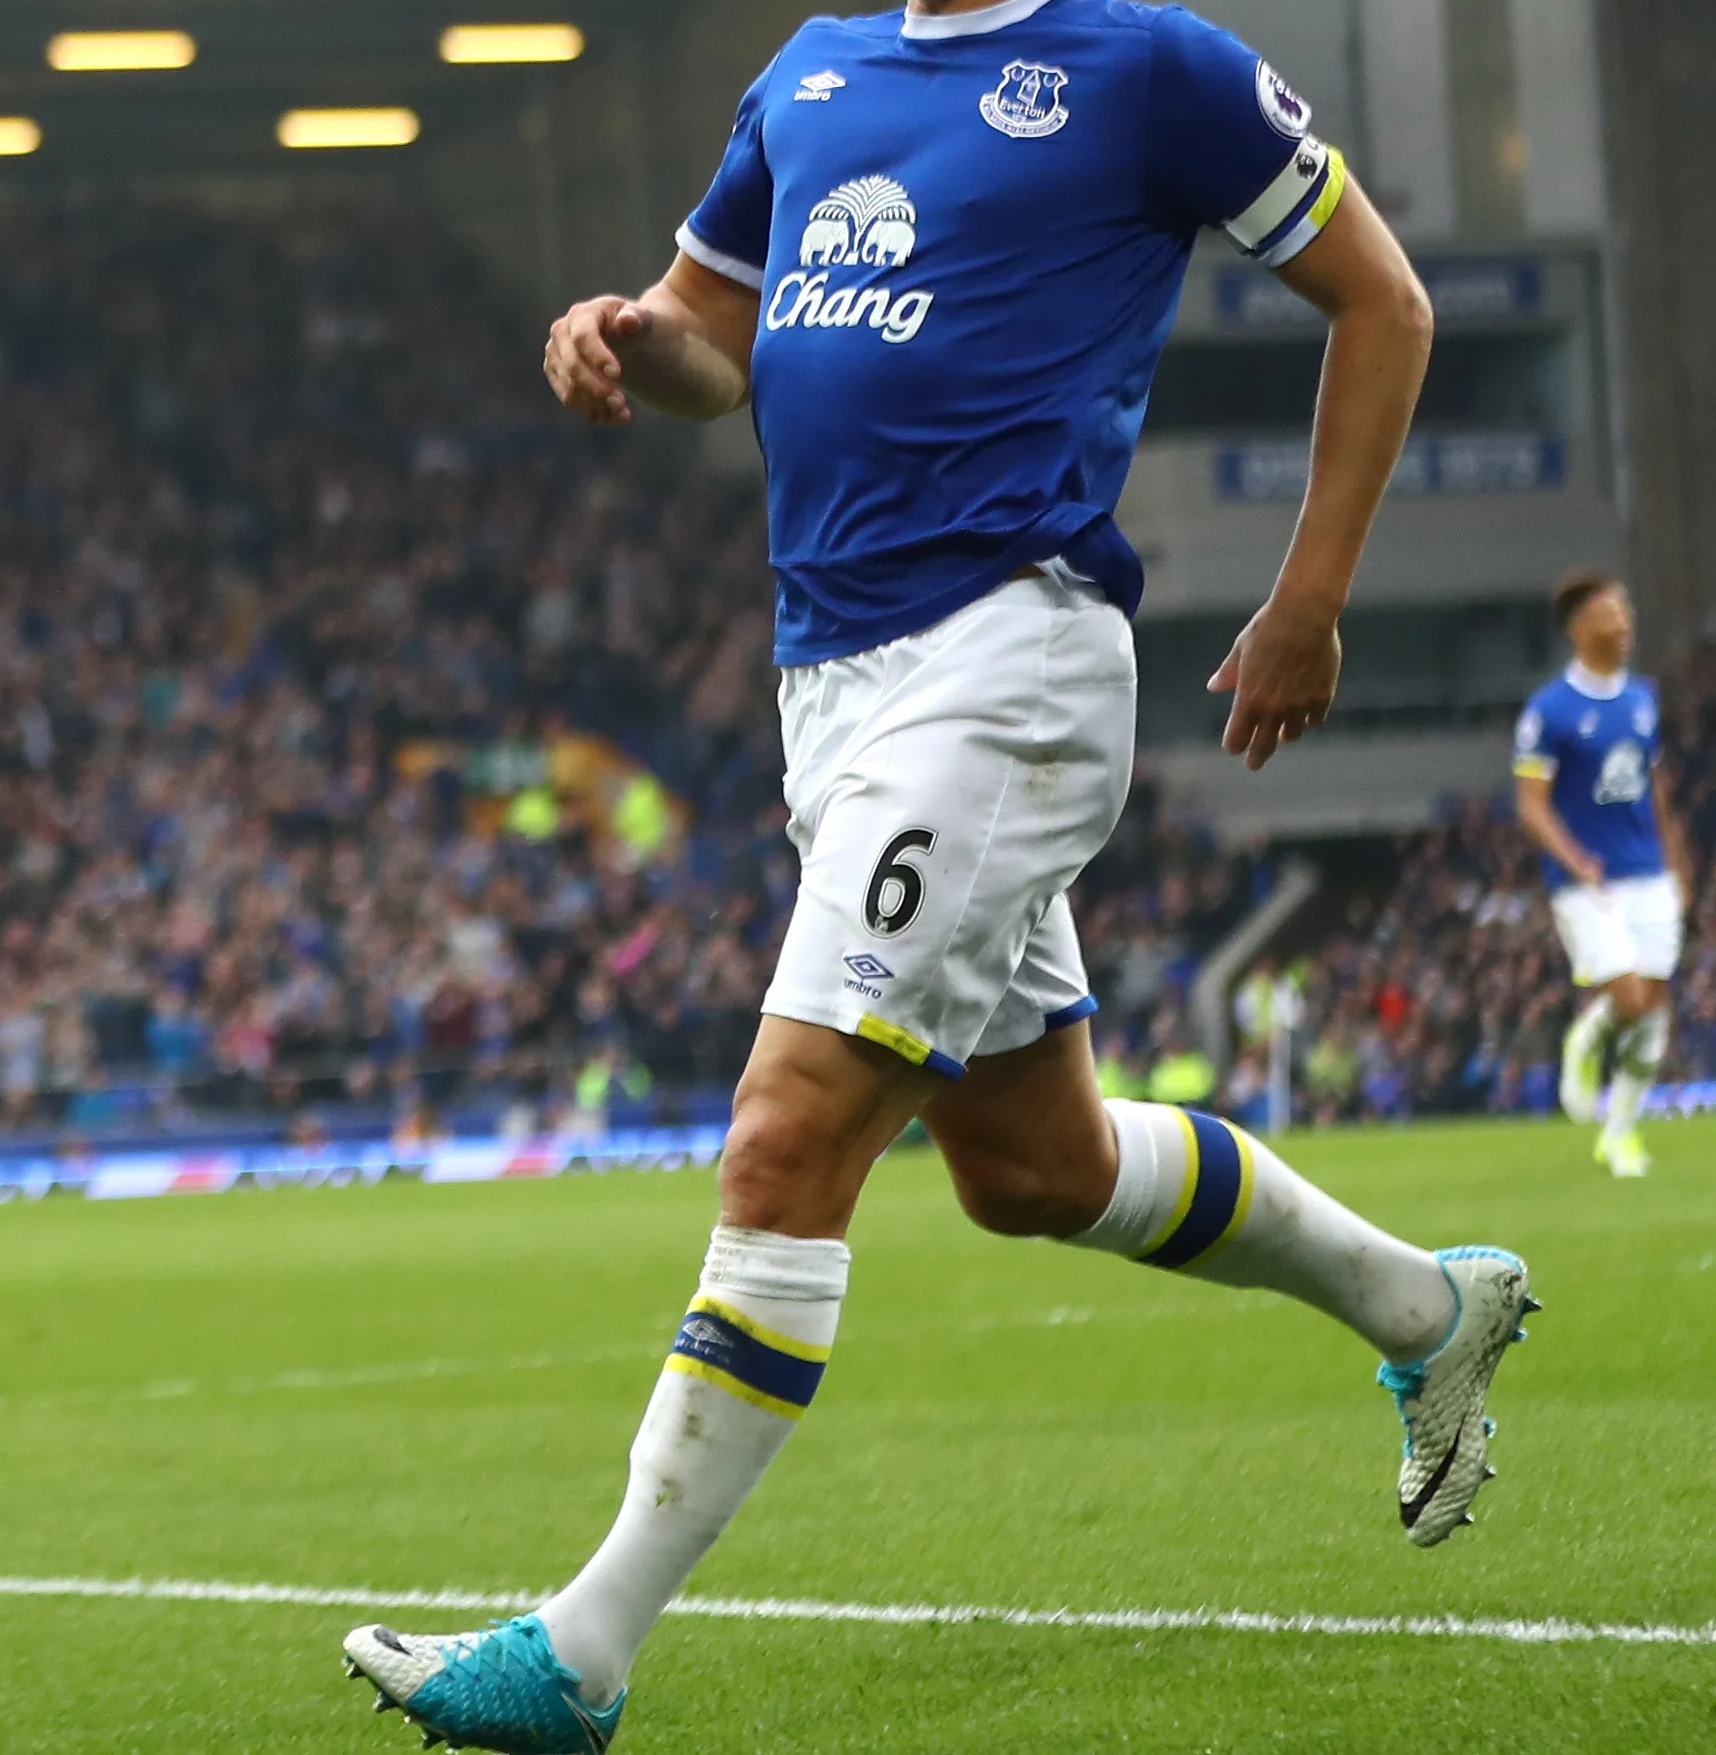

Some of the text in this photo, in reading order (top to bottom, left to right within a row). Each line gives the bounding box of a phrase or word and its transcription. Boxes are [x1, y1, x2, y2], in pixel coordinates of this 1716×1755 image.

[766, 271, 935, 344] Chang
[861, 826, 940, 939] 6
[843, 977, 883, 1000] umbro
